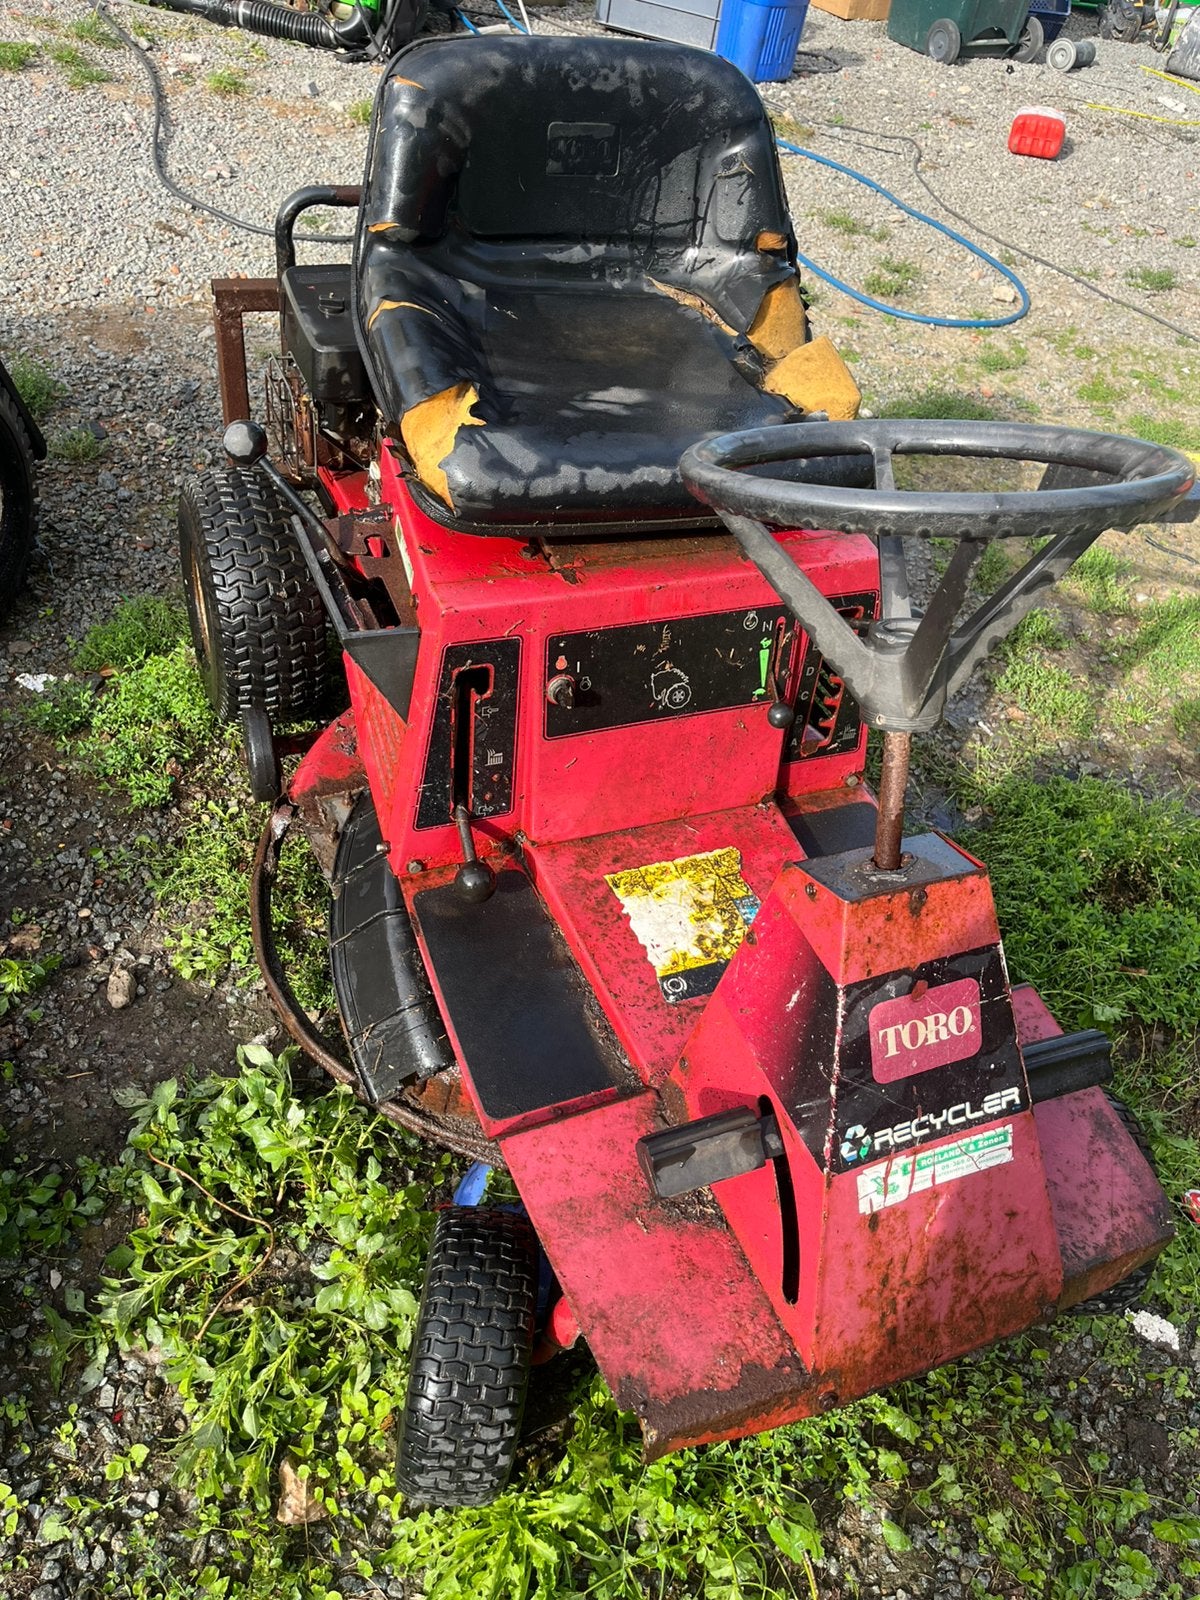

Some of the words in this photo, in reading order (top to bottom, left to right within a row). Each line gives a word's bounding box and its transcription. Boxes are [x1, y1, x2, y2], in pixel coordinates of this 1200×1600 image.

[806, 666, 815, 677] D
[800, 691, 809, 701] C
[790, 738, 798, 747] A
[878, 1005, 973, 1058] TORO
[873, 1086, 1021, 1151] RECYCLER
[978, 1135, 1005, 1148] Zonen
